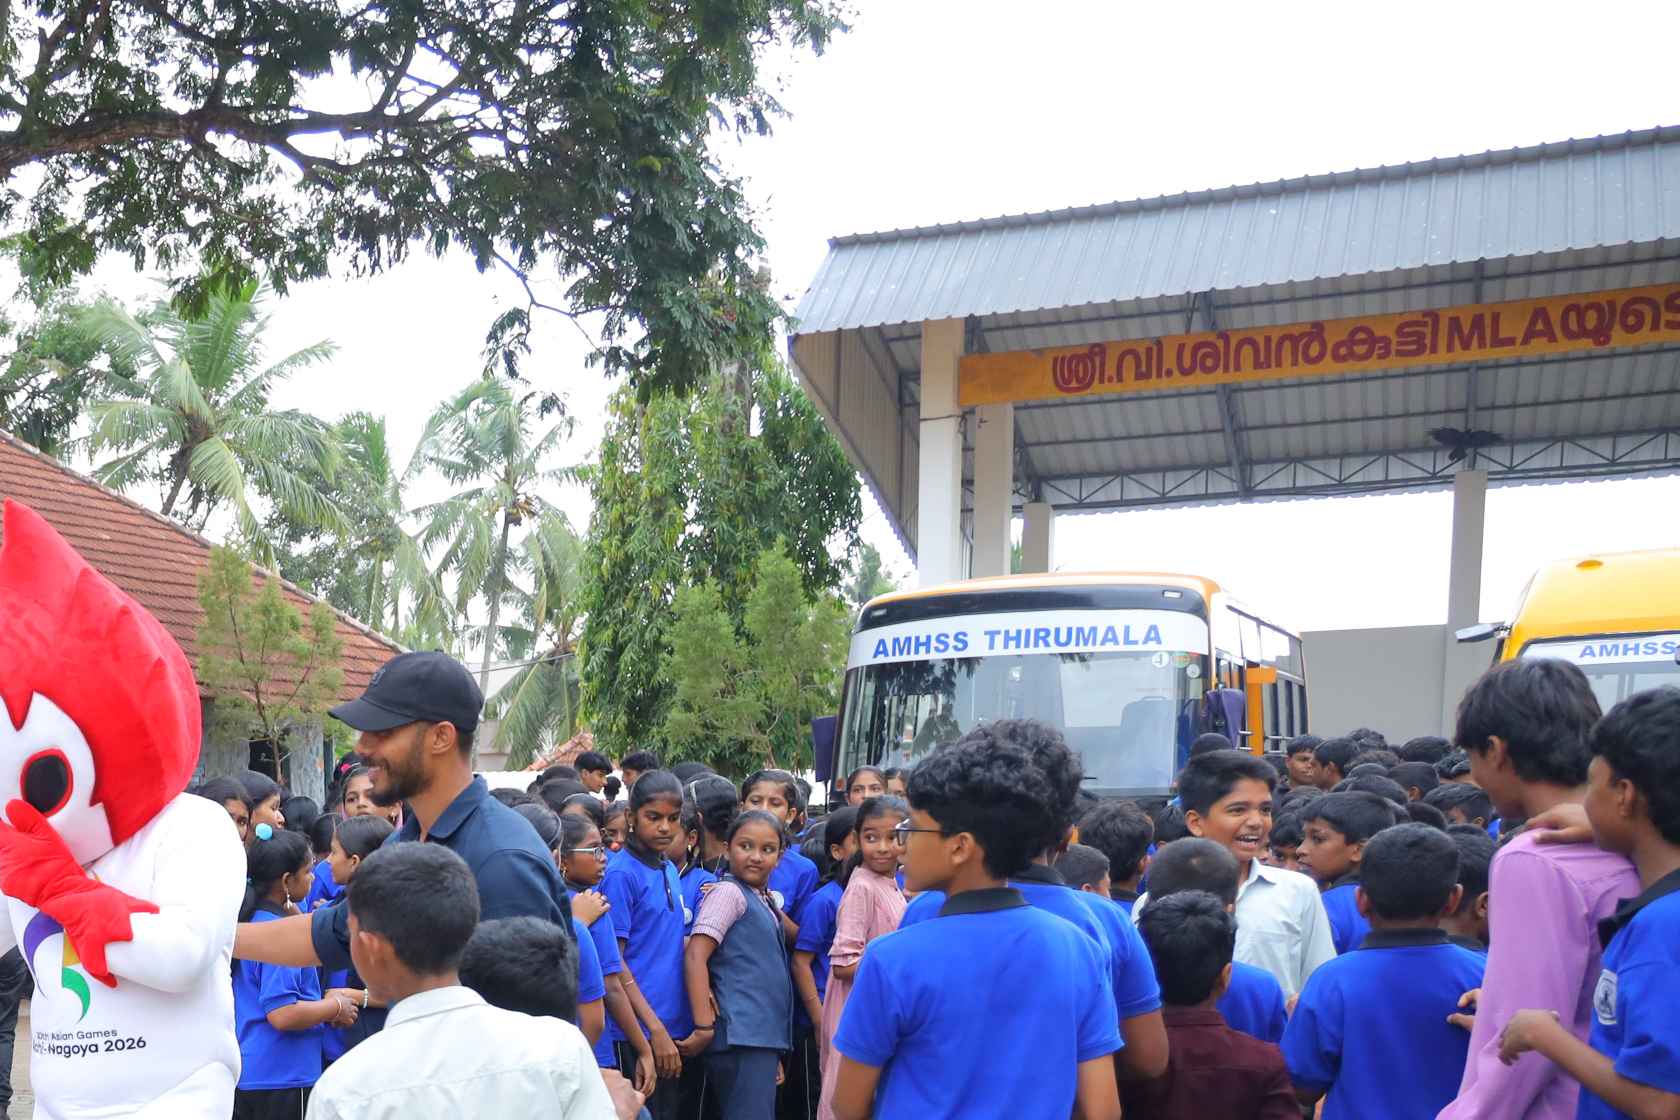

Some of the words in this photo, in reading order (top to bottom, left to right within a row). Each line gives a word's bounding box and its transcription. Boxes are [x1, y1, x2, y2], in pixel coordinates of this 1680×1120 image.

[872, 631, 969, 659] AMHSS
[984, 623, 1163, 650] THIRUMALA
[1579, 641, 1676, 658] AMHSS
[51, 1031, 74, 1041] Asian
[76, 1029, 118, 1040] Games
[104, 1036, 147, 1053] 2026
